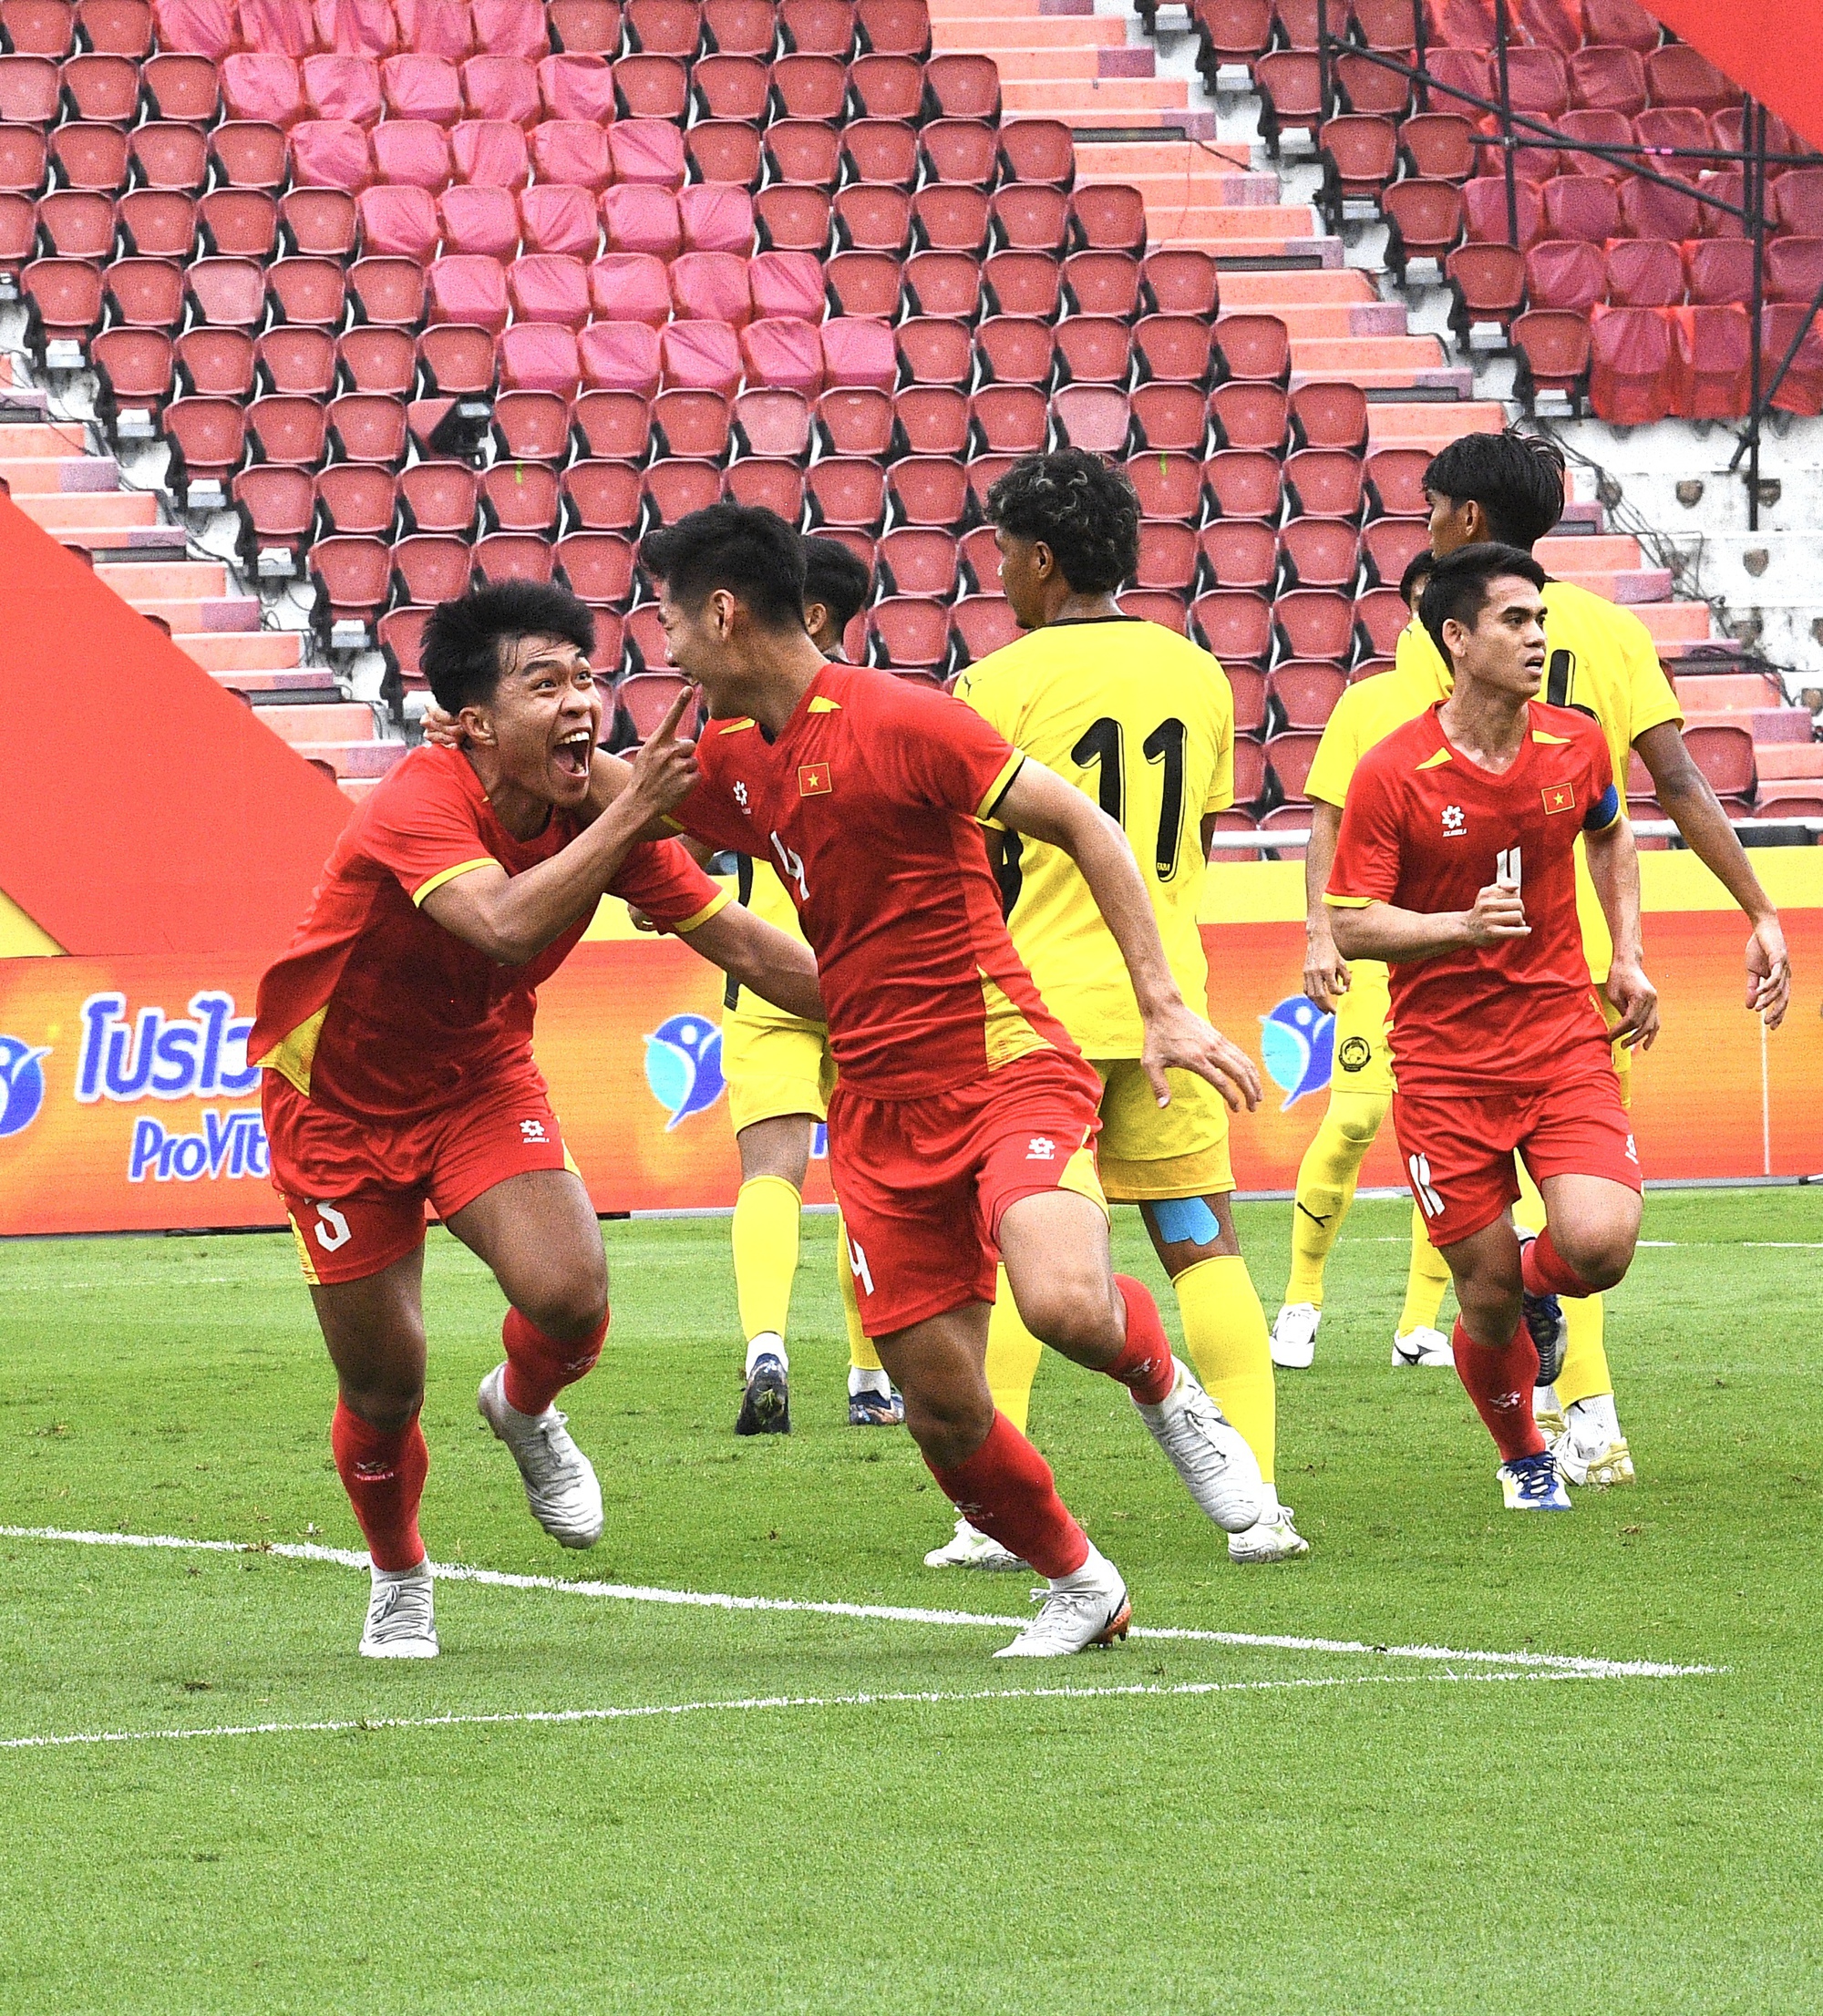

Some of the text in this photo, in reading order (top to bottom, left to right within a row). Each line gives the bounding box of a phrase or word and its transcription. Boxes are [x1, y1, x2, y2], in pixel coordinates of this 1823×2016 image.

[1070, 716, 1188, 883] 11
[769, 829, 810, 901] 4
[1408, 1152, 1446, 1219] 11
[843, 1220, 875, 1297] 4
